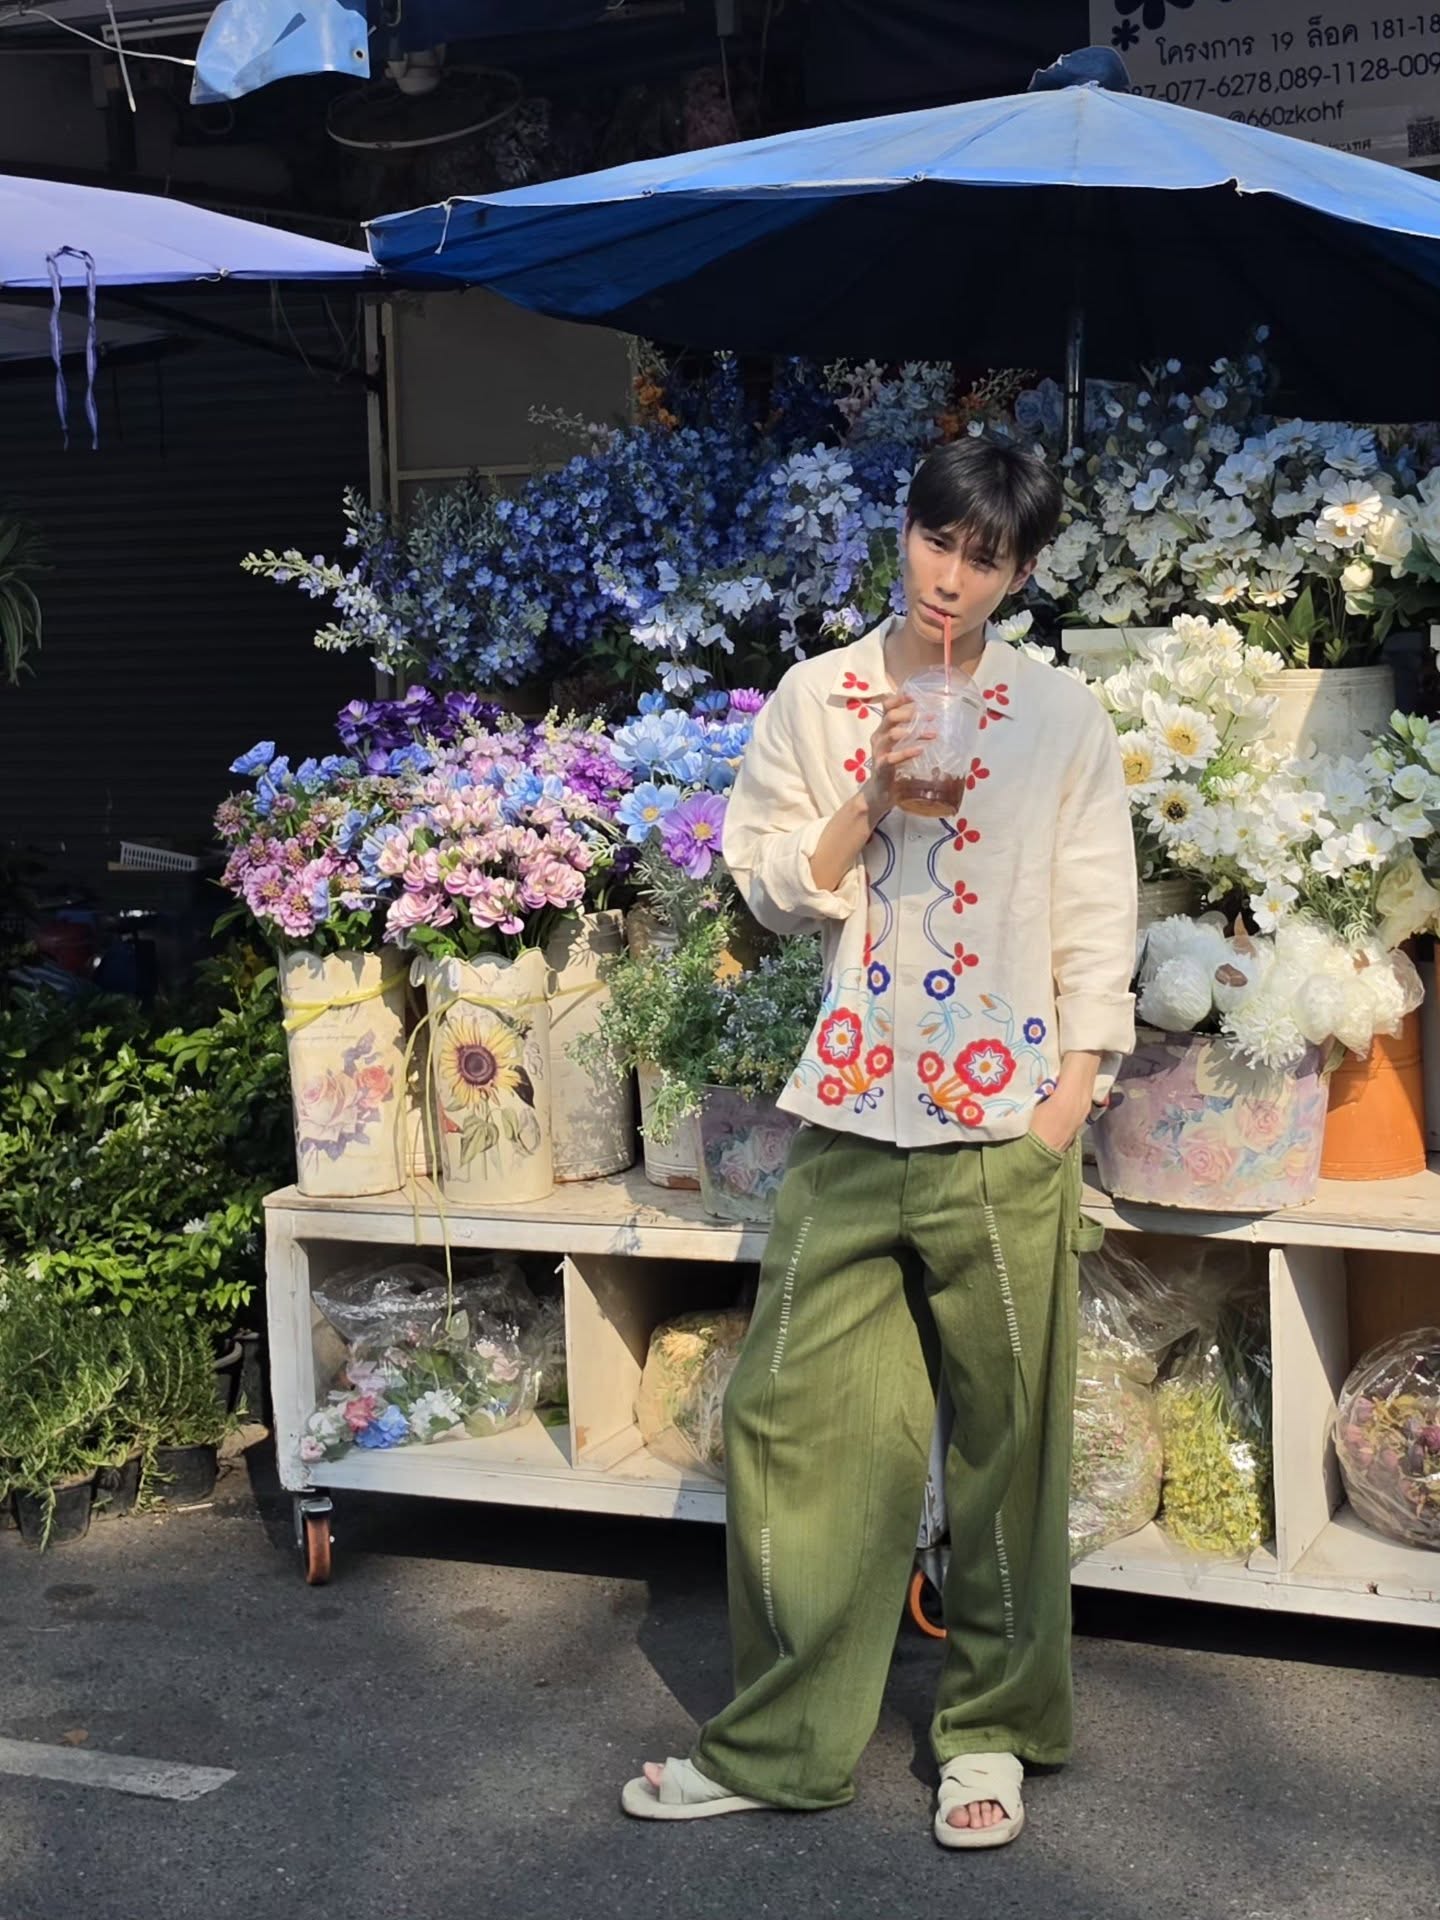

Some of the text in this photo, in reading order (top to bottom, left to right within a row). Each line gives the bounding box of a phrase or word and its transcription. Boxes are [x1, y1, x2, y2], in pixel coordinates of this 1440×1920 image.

[1155, 13, 1440, 66] โครงการ 19 ล็อค 181-18
[1121, 52, 1440, 104] 7-077-6278,089-1128-009
